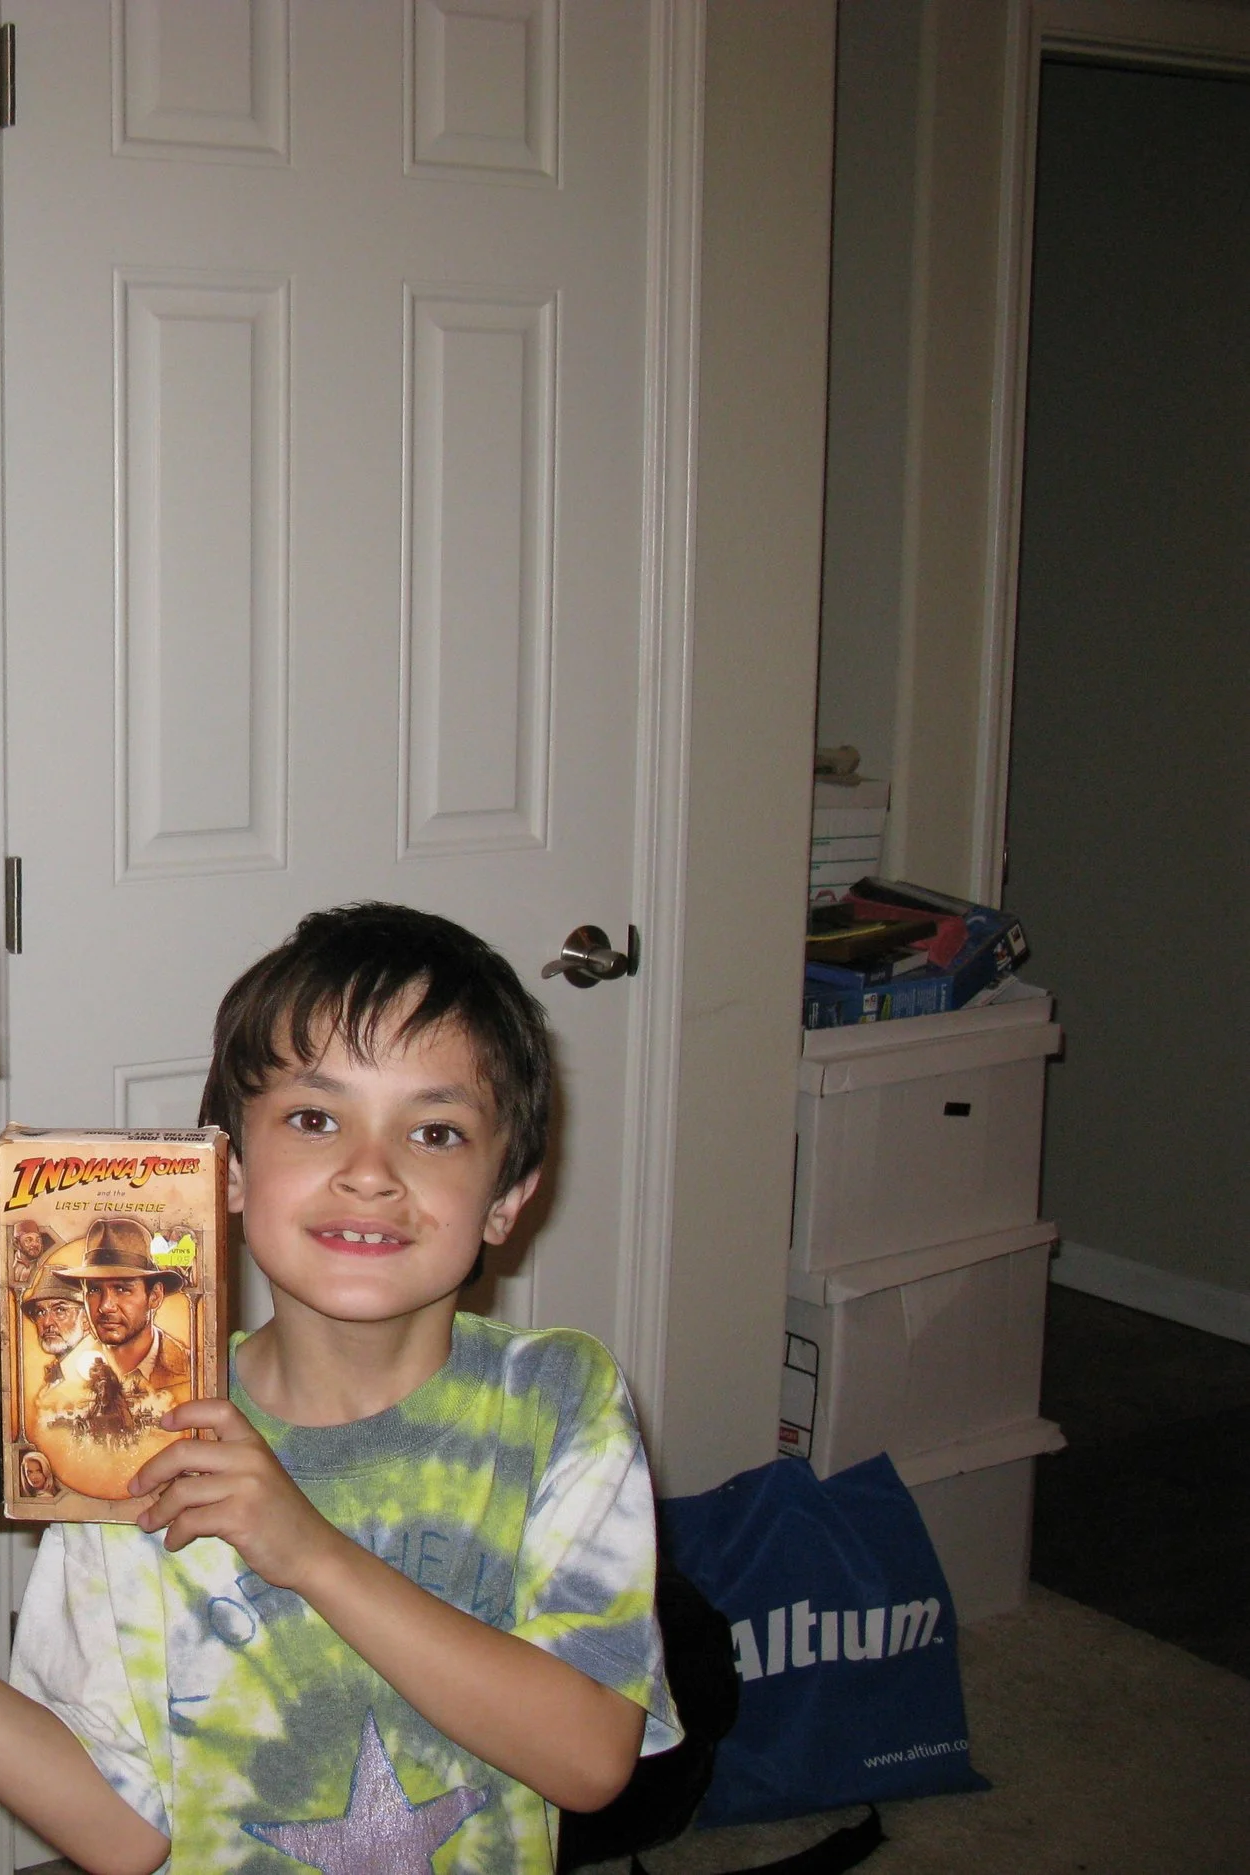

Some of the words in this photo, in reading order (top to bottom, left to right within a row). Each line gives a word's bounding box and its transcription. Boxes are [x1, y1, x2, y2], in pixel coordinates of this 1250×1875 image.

[4, 1156, 138, 1212] INDIANA
[129, 1156, 200, 1189] JONES
[55, 1200, 90, 1211] LAST
[93, 1202, 166, 1213] CRUSADE
[730, 1597, 941, 1683] Altium
[863, 1739, 968, 1768] www.altium.co
